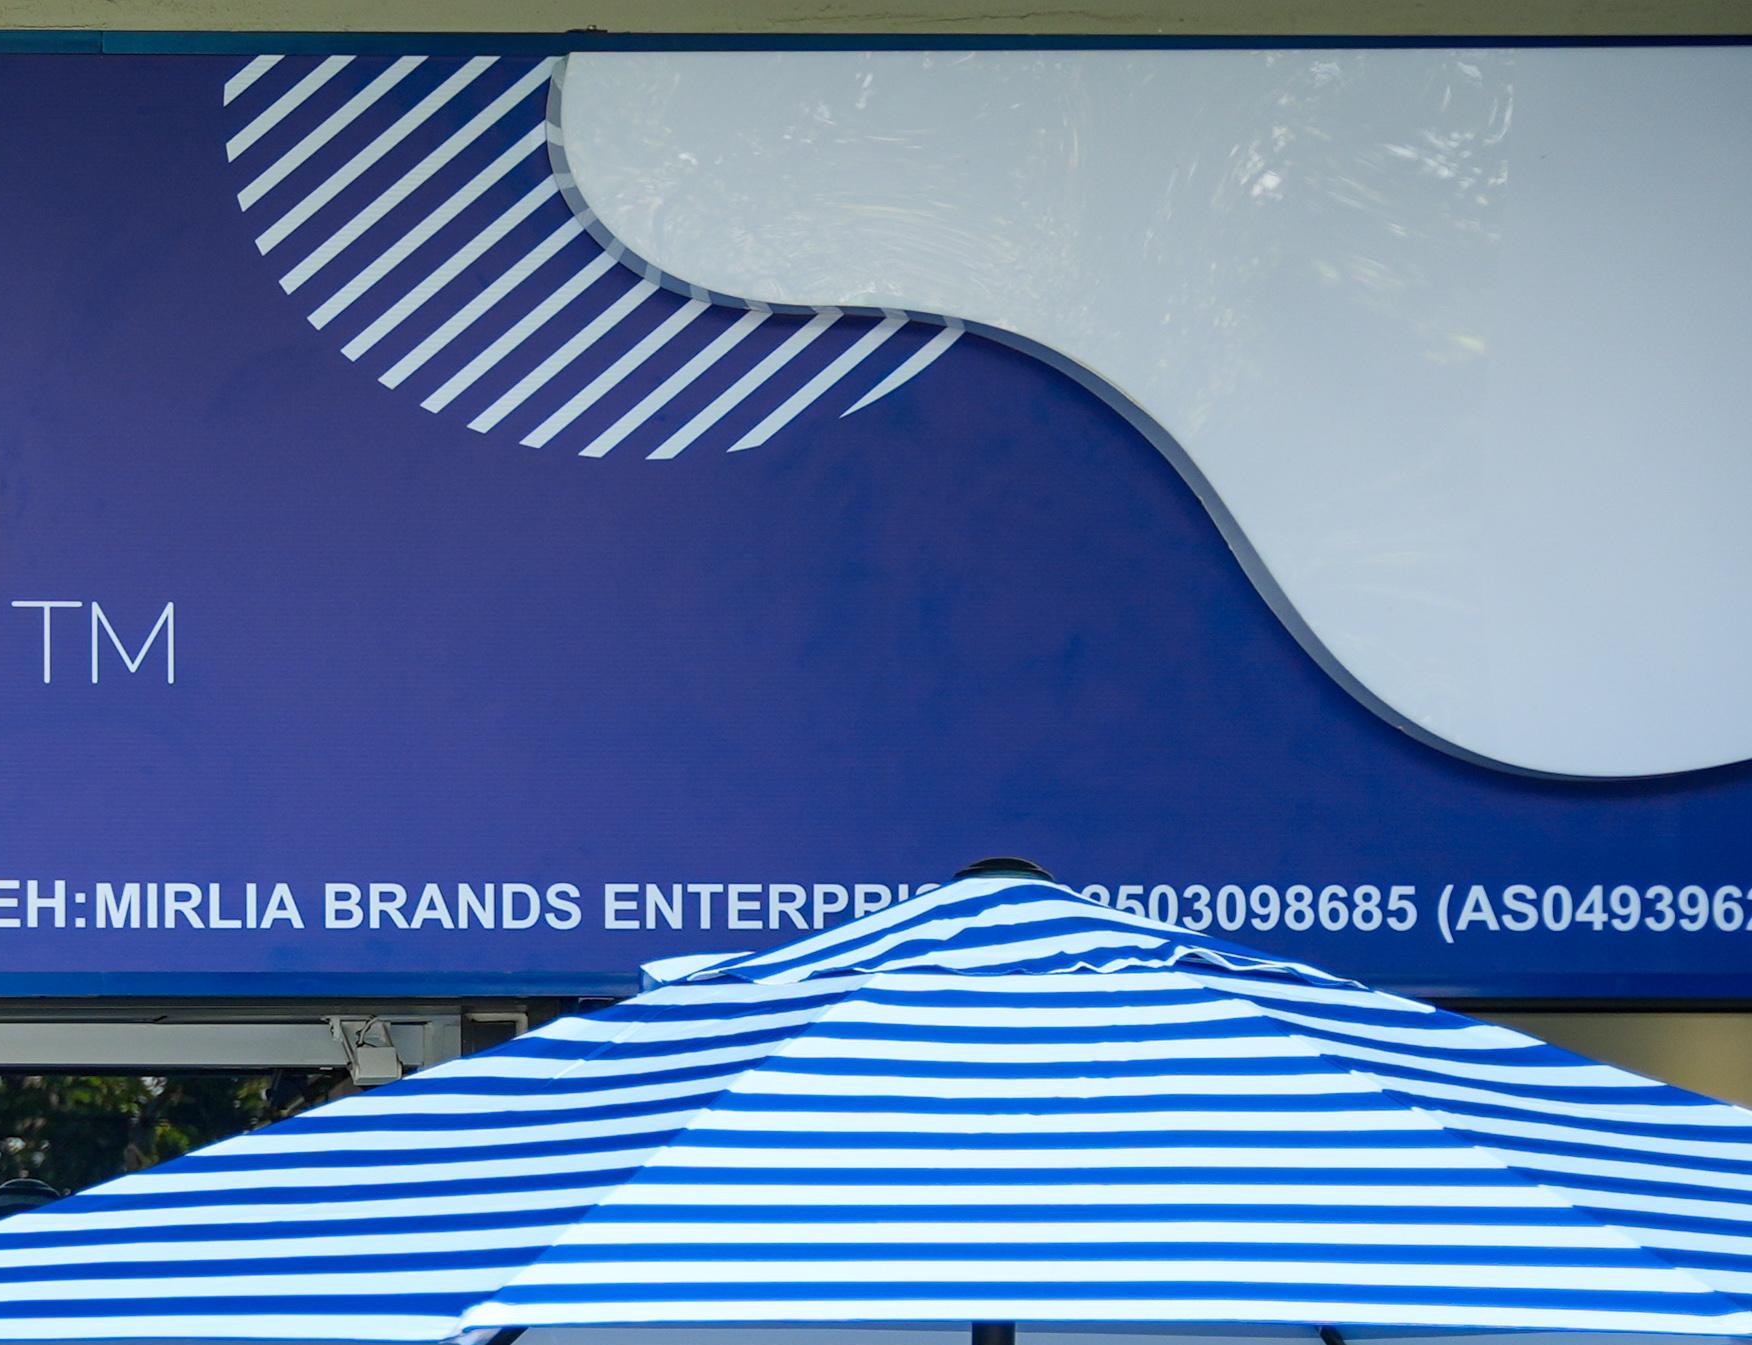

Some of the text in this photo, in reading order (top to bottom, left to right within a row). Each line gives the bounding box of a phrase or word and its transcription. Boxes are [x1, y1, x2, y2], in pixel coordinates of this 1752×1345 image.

[10, 600, 175, 685] TM
[324, 882, 583, 931] BRANDS
[604, 882, 942, 931] ENTERPR
[1436, 883, 1752, 944] (AS049396
